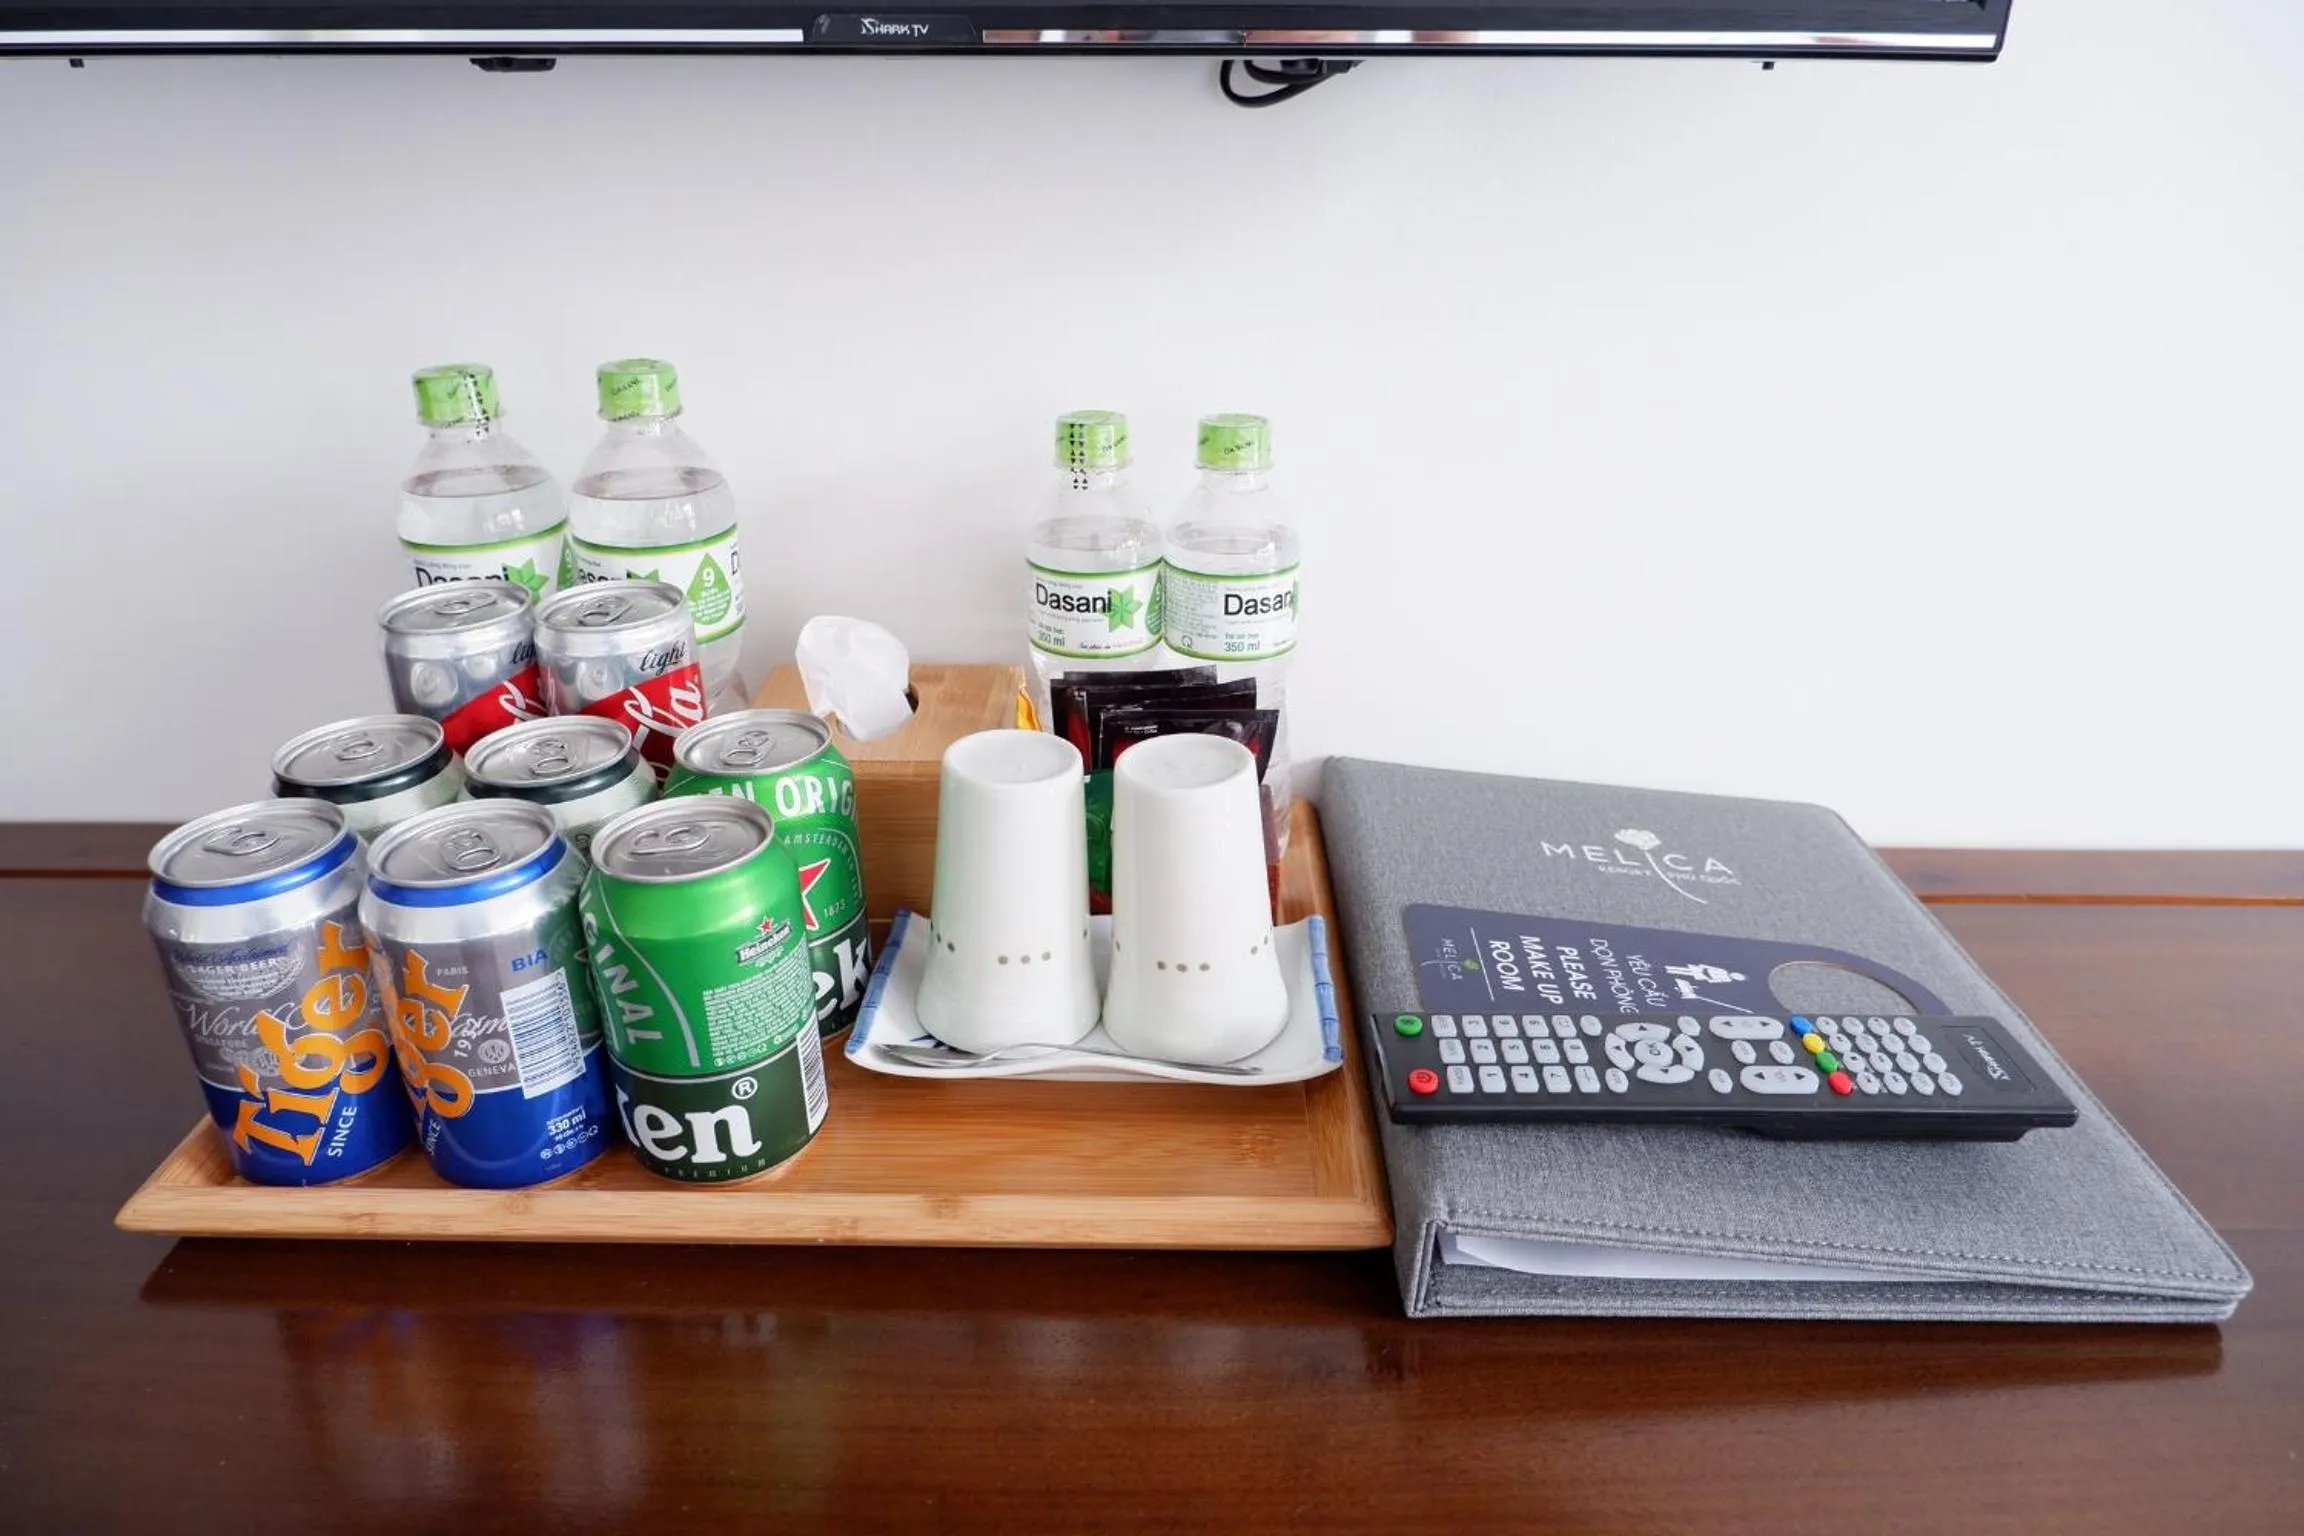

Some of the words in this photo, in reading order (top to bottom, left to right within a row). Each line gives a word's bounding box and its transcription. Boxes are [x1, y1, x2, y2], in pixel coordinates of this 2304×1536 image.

[860, 17, 909, 35] SHARK
[913, 25, 929, 37] TV
[702, 567, 715, 587] 9
[1036, 582, 1112, 614] Dasani
[1223, 590, 1292, 616] Dasan
[1223, 641, 1244, 652] 350
[1247, 639, 1260, 651] ml
[241, 958, 278, 972] BEER
[437, 965, 469, 977] PARIS
[511, 949, 548, 973] BIA
[1489, 940, 1526, 993] ROOM
[1519, 934, 1549, 980] MAKE
[1537, 981, 1565, 1005] UP
[1556, 945, 1598, 1001] PLEASE
[232, 919, 390, 1167] Tiger
[1648, 1040, 1661, 1056] OK
[468, 1063, 516, 1078] GENEVA
[328, 1106, 357, 1158] SINCE
[548, 1119, 570, 1136] 330
